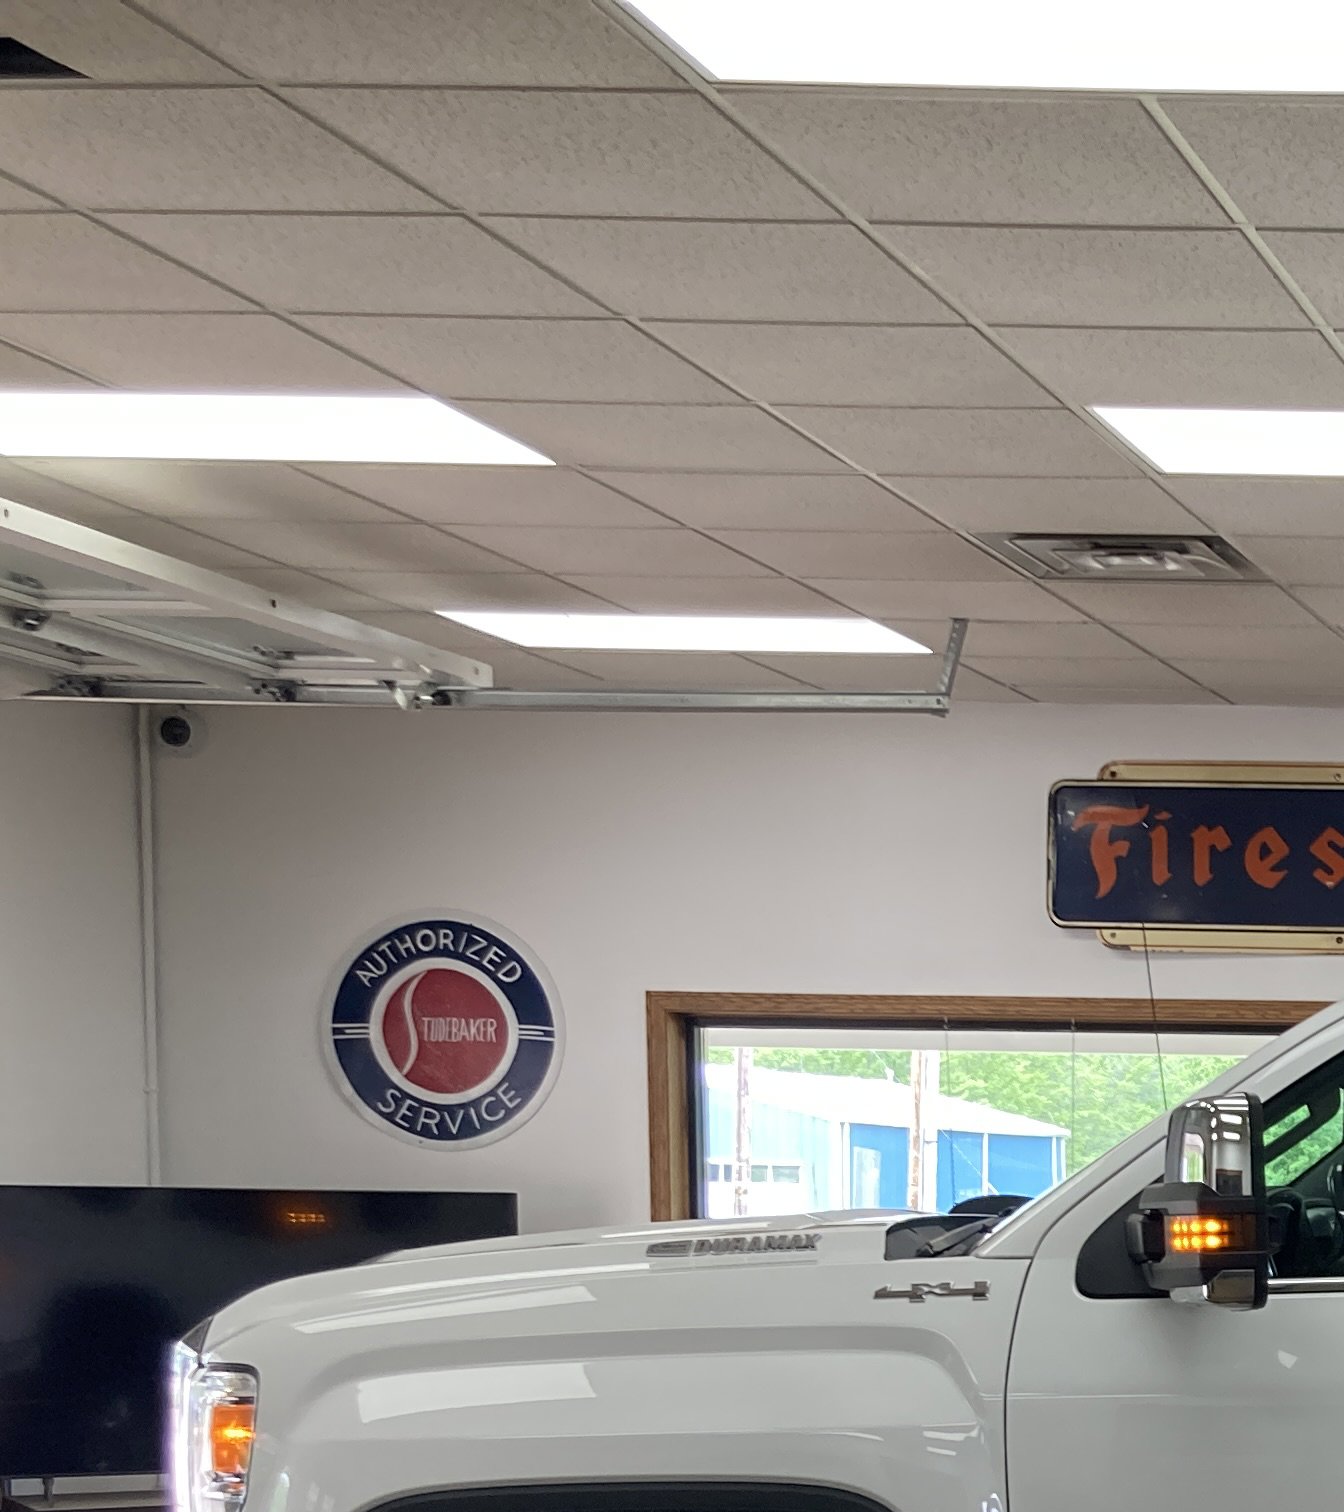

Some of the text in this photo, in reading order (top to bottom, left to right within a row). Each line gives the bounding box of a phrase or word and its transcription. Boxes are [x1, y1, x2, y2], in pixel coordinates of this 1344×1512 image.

[355, 929, 522, 987] AUTHORIZED
[377, 1082, 522, 1136] SERVICE
[693, 1234, 822, 1256] DURAMAX
